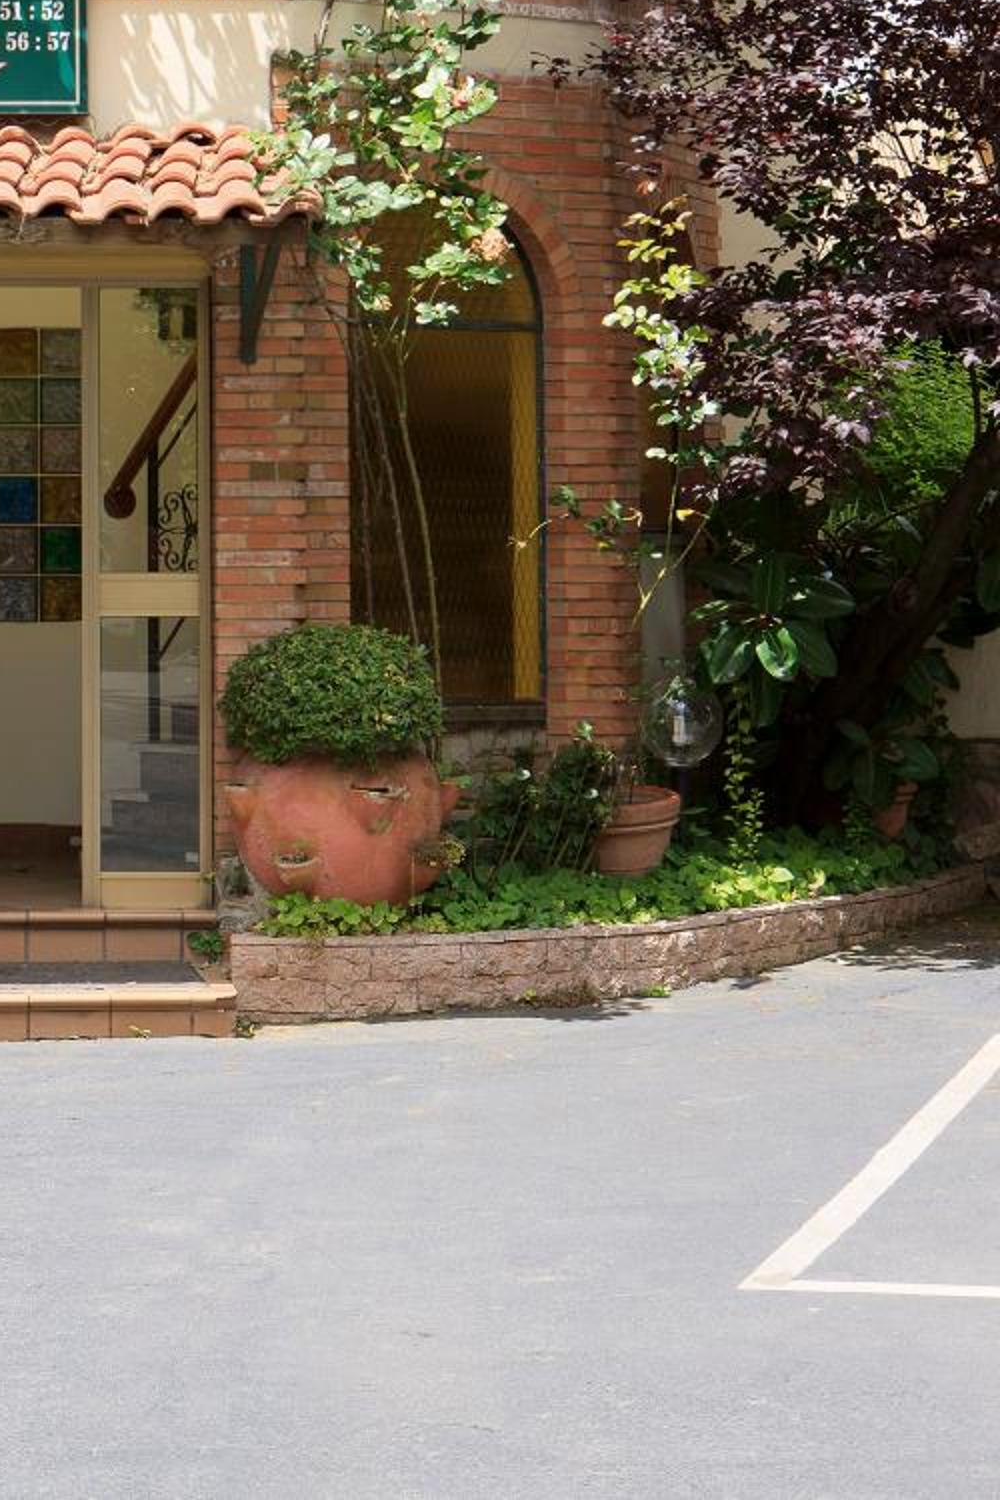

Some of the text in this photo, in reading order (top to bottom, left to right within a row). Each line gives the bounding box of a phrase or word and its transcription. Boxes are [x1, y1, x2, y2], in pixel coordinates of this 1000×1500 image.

[0, 1, 23, 21] 51
[41, 0, 65, 21] 52
[5, 31, 30, 52] 56
[47, 31, 71, 52] 57
